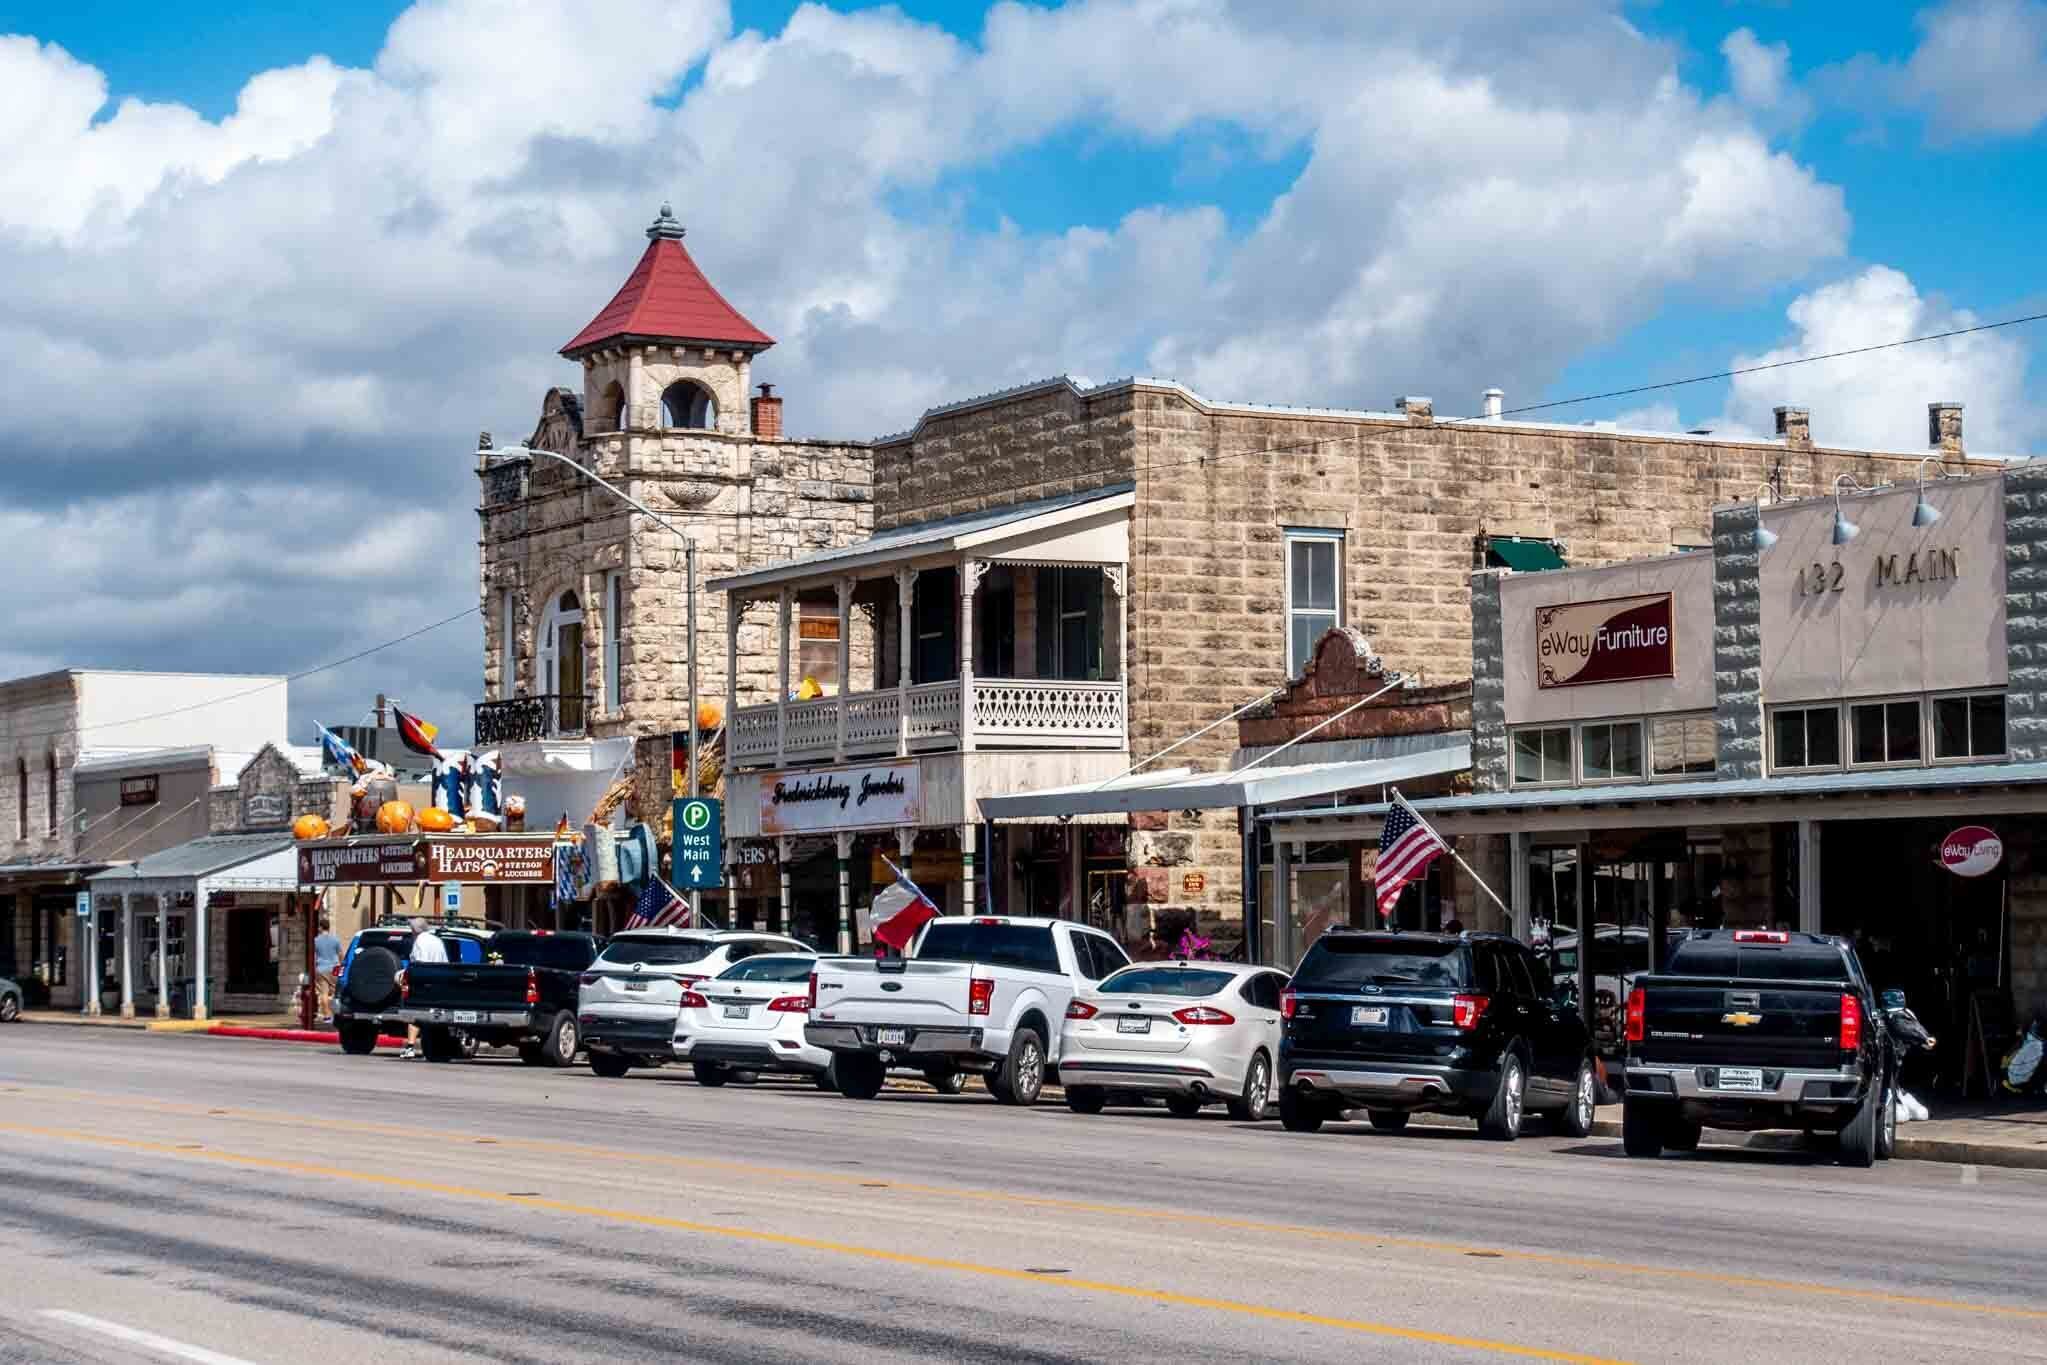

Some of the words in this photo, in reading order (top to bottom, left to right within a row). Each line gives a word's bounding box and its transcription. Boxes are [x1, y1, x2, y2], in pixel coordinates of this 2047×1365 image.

[1798, 560, 1845, 597] 132
[1875, 546, 1960, 588] MAIN
[1541, 631, 1590, 657] eWay
[1595, 623, 1668, 652] Furniture
[772, 775, 850, 809] Fredericksburg
[683, 834, 710, 846] West
[431, 844, 552, 860] HEADQUARTERS
[683, 848, 710, 861] Main
[438, 857, 480, 873] HATS
